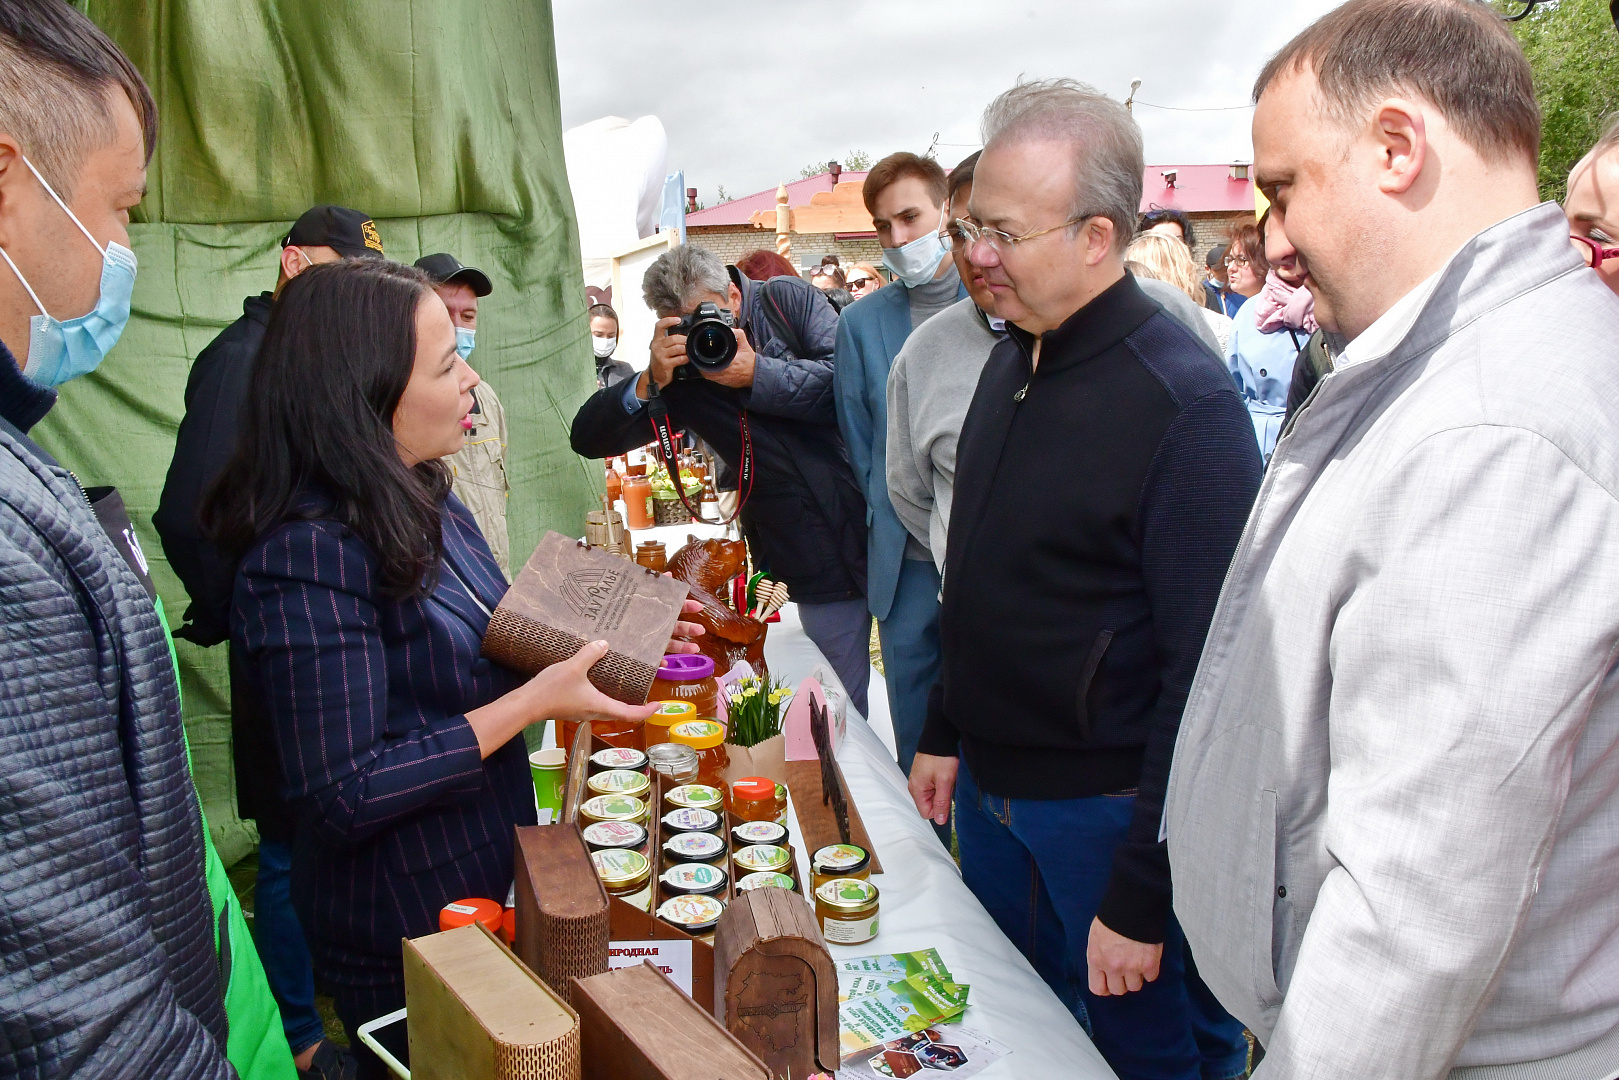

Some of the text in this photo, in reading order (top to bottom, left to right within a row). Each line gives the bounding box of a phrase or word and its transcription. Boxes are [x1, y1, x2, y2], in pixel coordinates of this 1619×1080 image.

[659, 425, 673, 460] Canon
[743, 472, 749, 481] IV
[584, 569, 620, 621] ЗАУРАЛЬЕ
[609, 947, 659, 957] ИРОДНАЯ
[846, 1006, 885, 1040] ЦЕЛЕБНАЯ СИЛА
[861, 1000, 892, 1027] БАШКИРИИ
[844, 1021, 870, 1043] ЗОЛОТОЙ
